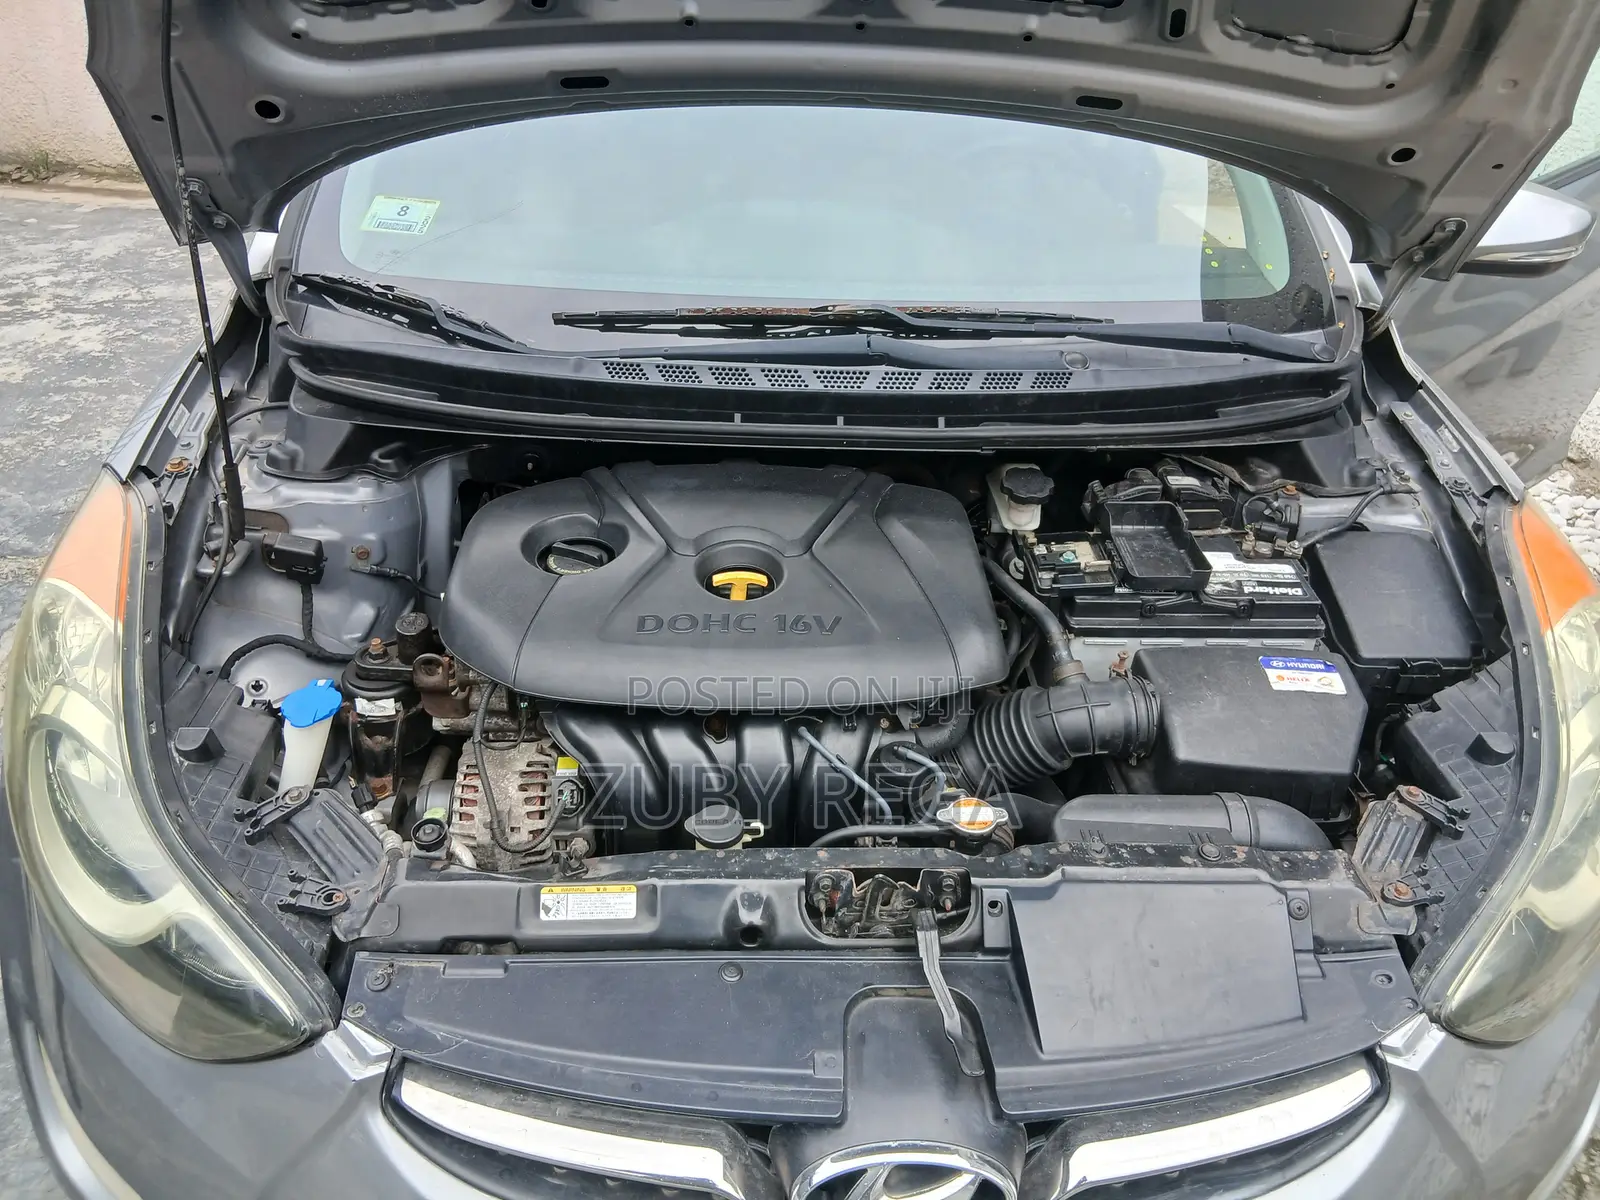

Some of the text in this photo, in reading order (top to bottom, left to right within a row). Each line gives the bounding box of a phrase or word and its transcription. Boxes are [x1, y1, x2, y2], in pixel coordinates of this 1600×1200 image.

[397, 205, 410, 217] 8
[1243, 586, 1303, 596] DieHard
[635, 613, 843, 635] DOHC 16V
[1286, 662, 1325, 670] HYUNDAI
